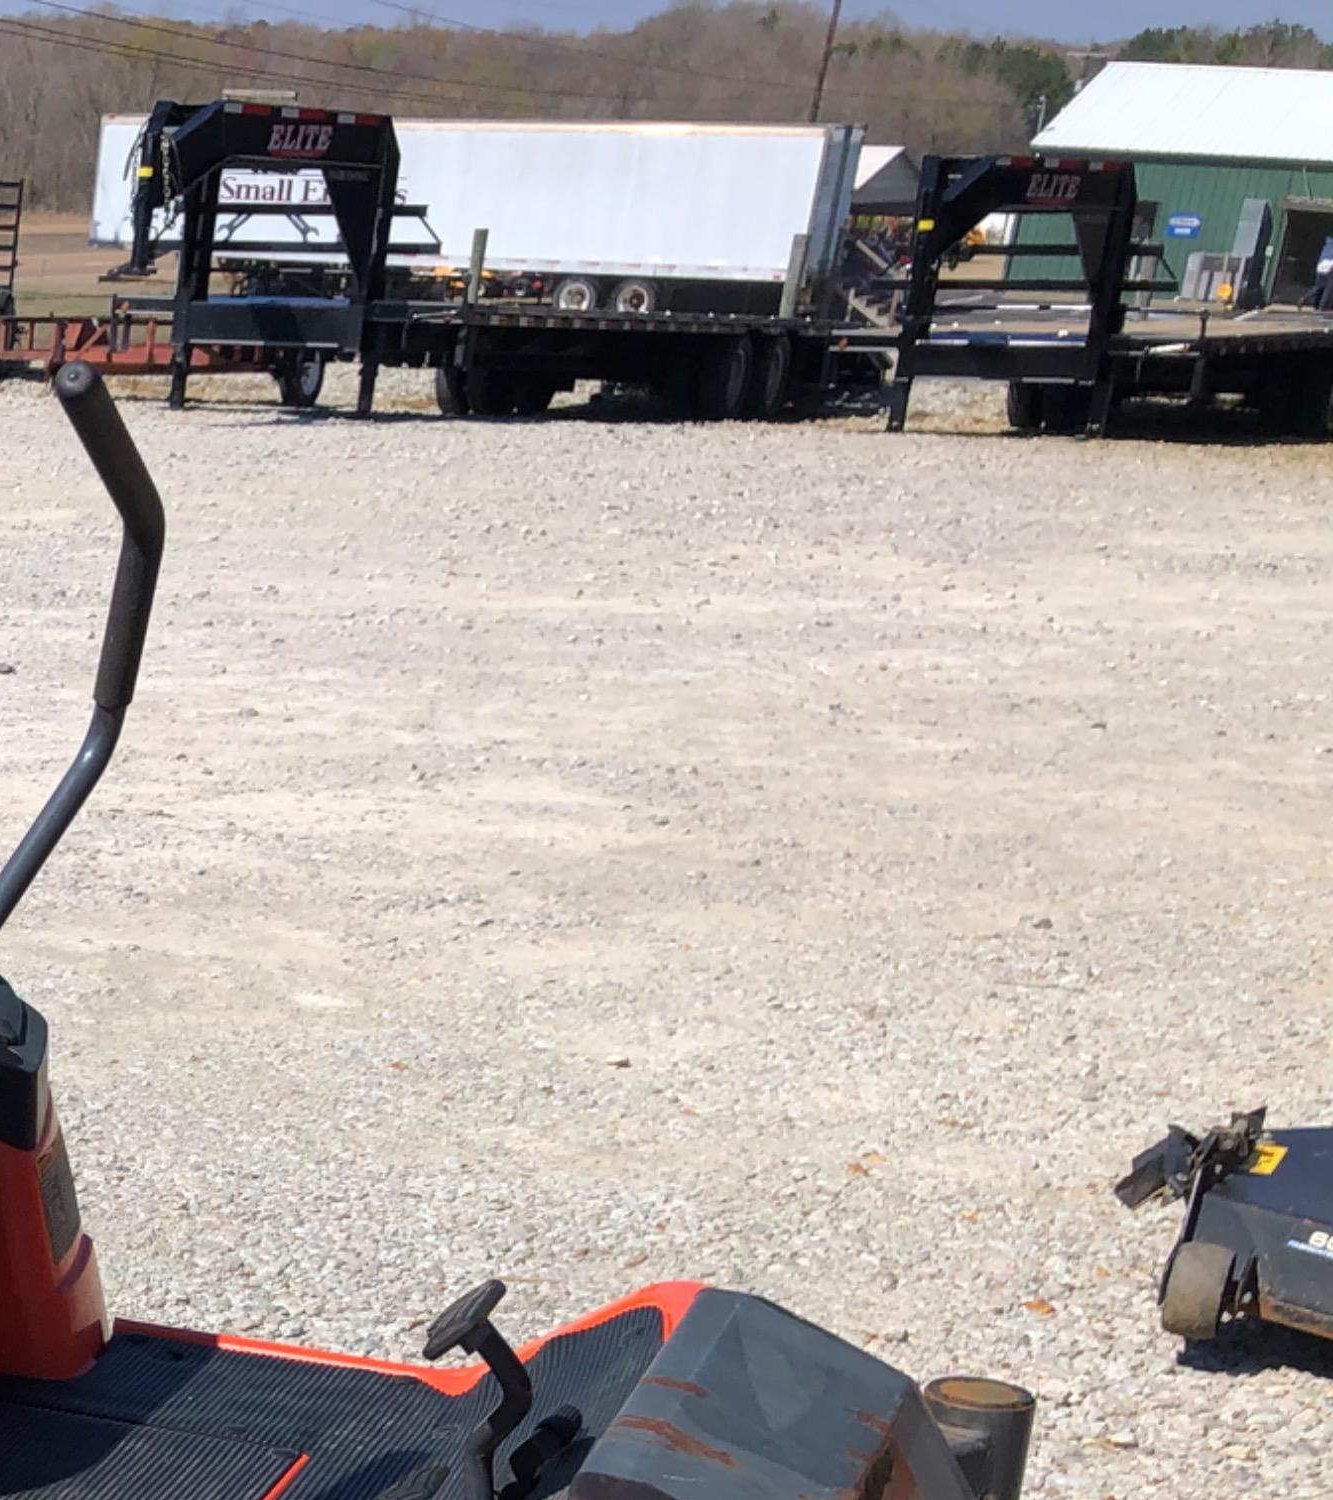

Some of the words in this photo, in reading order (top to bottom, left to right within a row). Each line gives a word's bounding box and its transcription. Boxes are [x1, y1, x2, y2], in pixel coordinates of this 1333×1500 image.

[267, 124, 333, 151] ELITE
[220, 175, 293, 203] Small
[1025, 174, 1082, 199] ELITE
